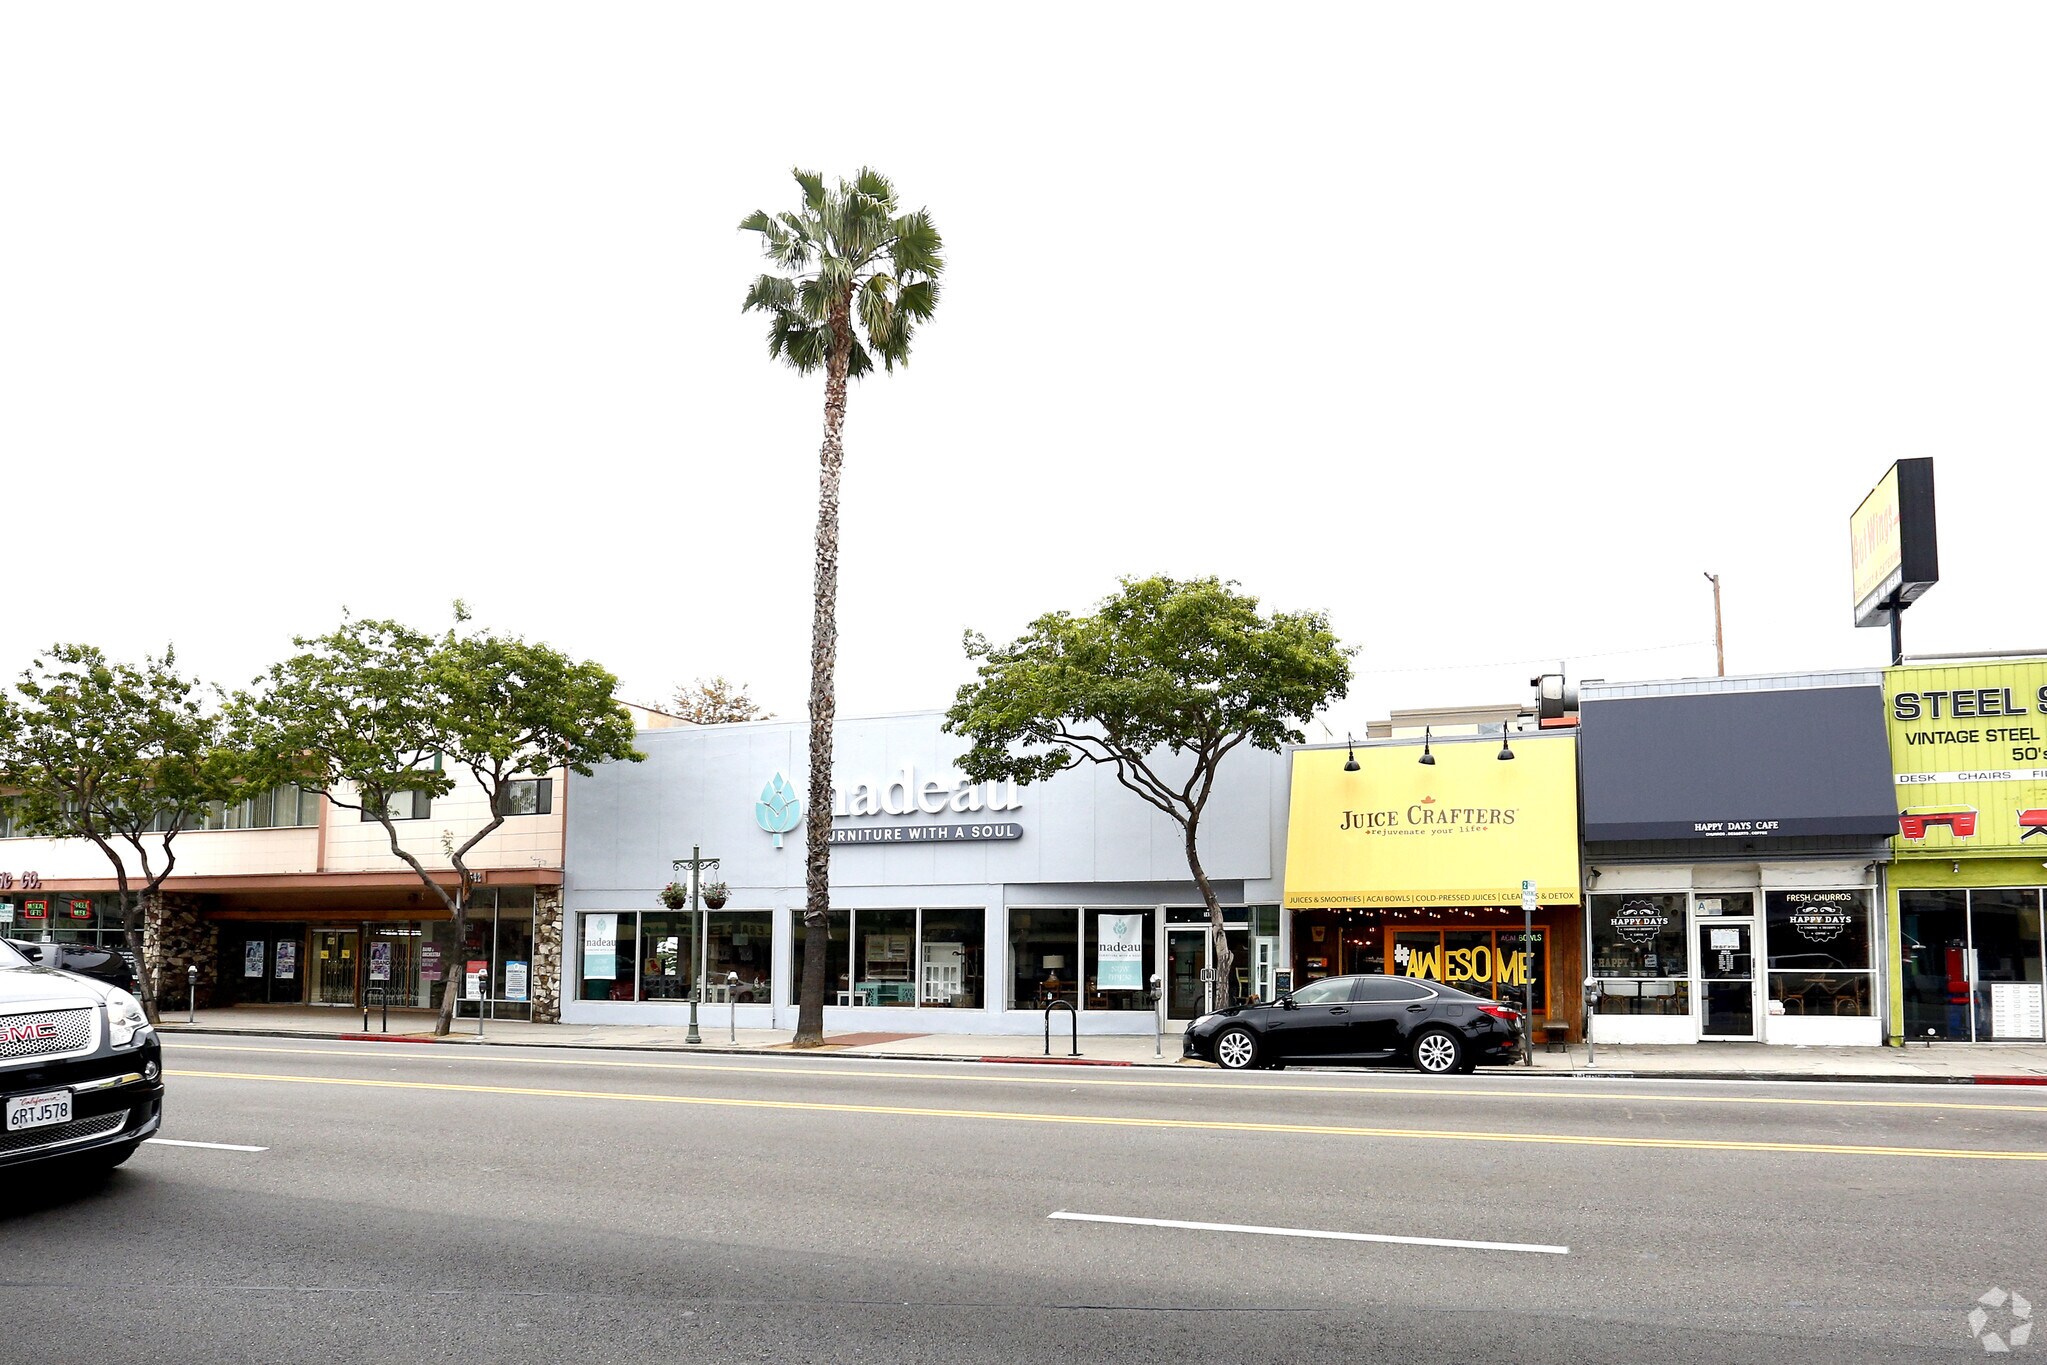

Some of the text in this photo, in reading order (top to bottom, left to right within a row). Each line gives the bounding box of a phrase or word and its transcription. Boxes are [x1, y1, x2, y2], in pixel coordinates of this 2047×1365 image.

[1894, 687, 2028, 720] STEEL
[1906, 728, 2040, 745] VINTAGE STEEL
[1900, 774, 1937, 783] DESK
[1958, 771, 2012, 780] CHAIRS
[1340, 805, 1515, 830] JUICE CRAFTERS
[1372, 828, 1426, 836] rejuvenate
[1460, 825, 1481, 833] life
[1694, 821, 1779, 831] HAPPY DAYS CAFE
[829, 825, 1015, 842] URNITURE WITH A SOUL
[21, 871, 42, 889] CO.
[1523, 881, 1528, 889] 2
[1415, 894, 1470, 902] COLD-PRESSED
[1471, 893, 1497, 901] JUICES
[1548, 892, 1574, 900] DETOX
[1786, 892, 1852, 902] FRESH CHURROS
[1698, 902, 1706, 910] A
[1610, 917, 1669, 926] HAPPY DAYS
[1790, 915, 1852, 924] HAPPY DAYS
[586, 937, 616, 947] nadeau
[1099, 941, 1141, 952] nadeau
[1598, 958, 1629, 968] HAPPY
[20, 1095, 60, 1106] California
[11, 1102, 68, 1125] 6RTJ578
